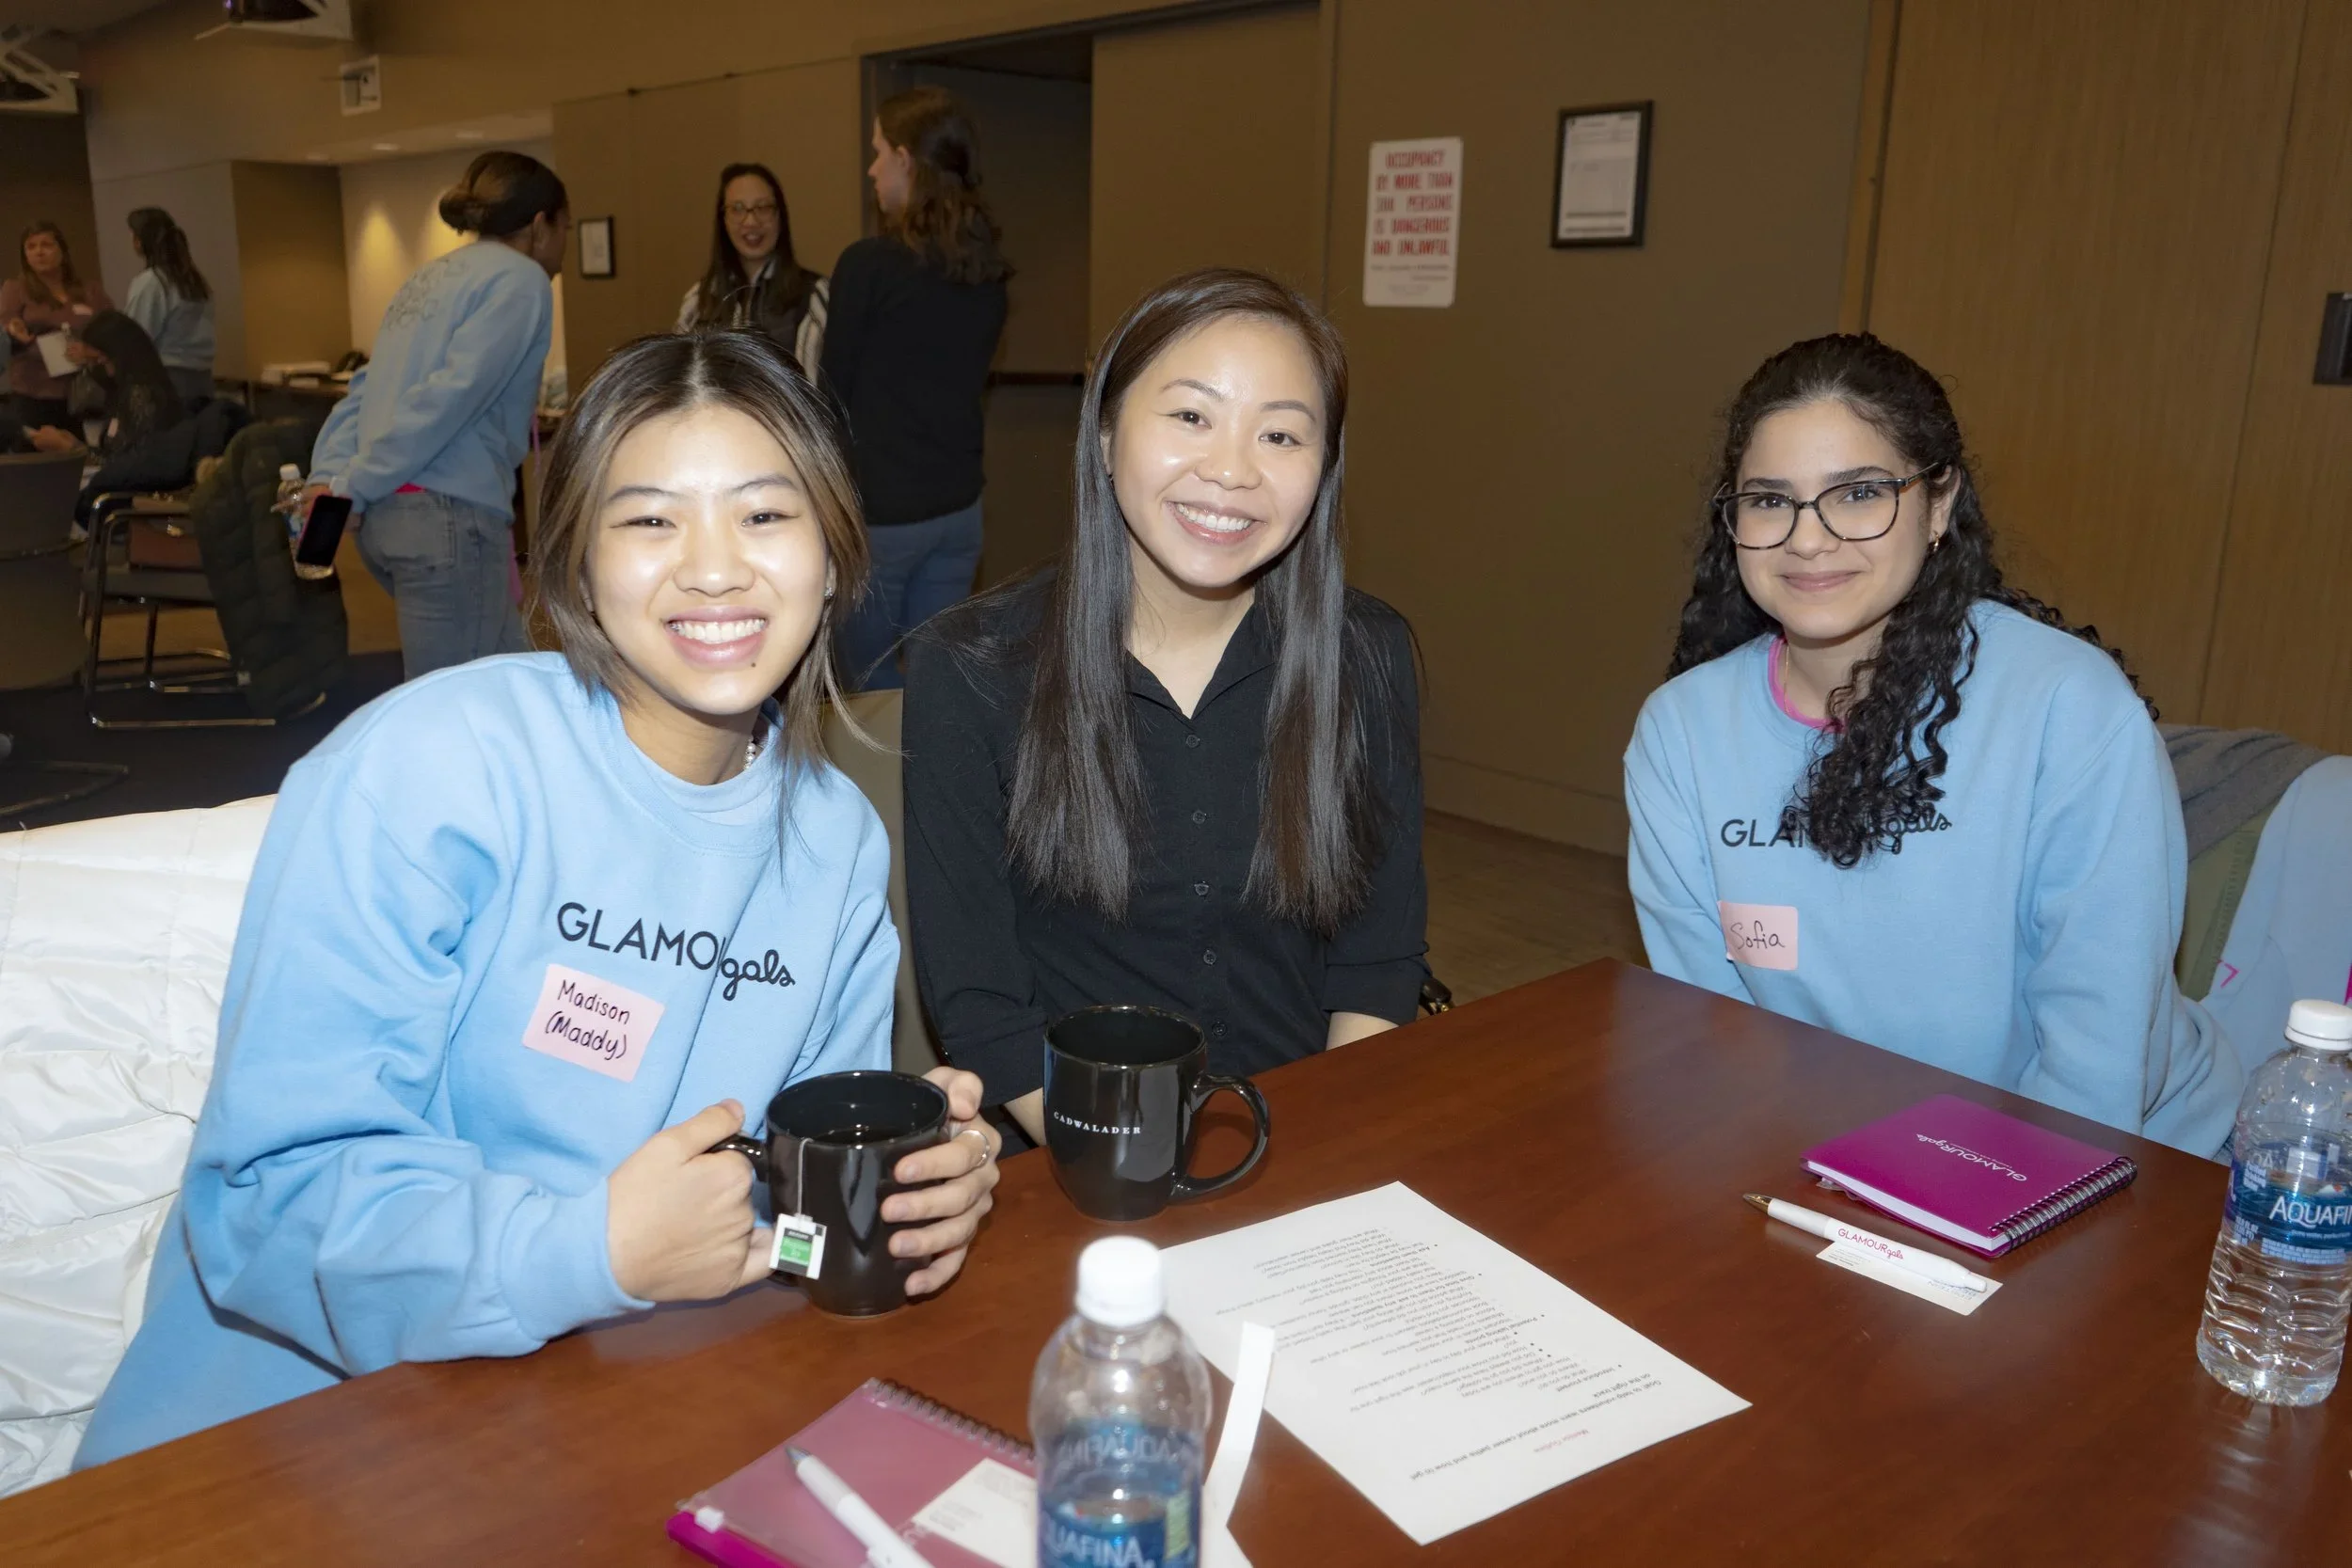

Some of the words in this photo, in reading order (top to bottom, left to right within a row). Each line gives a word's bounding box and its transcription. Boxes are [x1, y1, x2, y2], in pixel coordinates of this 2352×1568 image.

[1386, 150, 1446, 169] OCCUPANCY
[1394, 173, 1421, 190] MORE
[1428, 171, 1453, 188] THAN
[1406, 194, 1453, 212] PERSONS
[1391, 215, 1450, 234] DANGEROUS
[1373, 239, 1391, 256] AND
[1398, 238, 1450, 256] UNLAWFUL
[1730, 920, 1786, 949] Sofia
[557, 979, 630, 1025] Madison
[544, 1010, 628, 1061] (Maddy)
[1054, 1111, 1141, 1134] CADWALADER
[1916, 1133, 2027, 1181] GLAMOURgals
[1838, 1228, 1903, 1260] GLAMOURgals
[1589, 1387, 1613, 1398] track
[1610, 1381, 1629, 1391] right
[1615, 1389, 1635, 1399] help
[1578, 1396, 1617, 1413] volunteers
[1539, 1418, 1561, 1429] more
[1558, 1410, 1581, 1420] learn
[1516, 1426, 1540, 1439] about
[1491, 1434, 1518, 1449] career
[1467, 1444, 1492, 1457] paths
[1433, 1461, 1454, 1471] how
[1450, 1454, 1469, 1465] and
[1408, 1470, 1424, 1481] get
